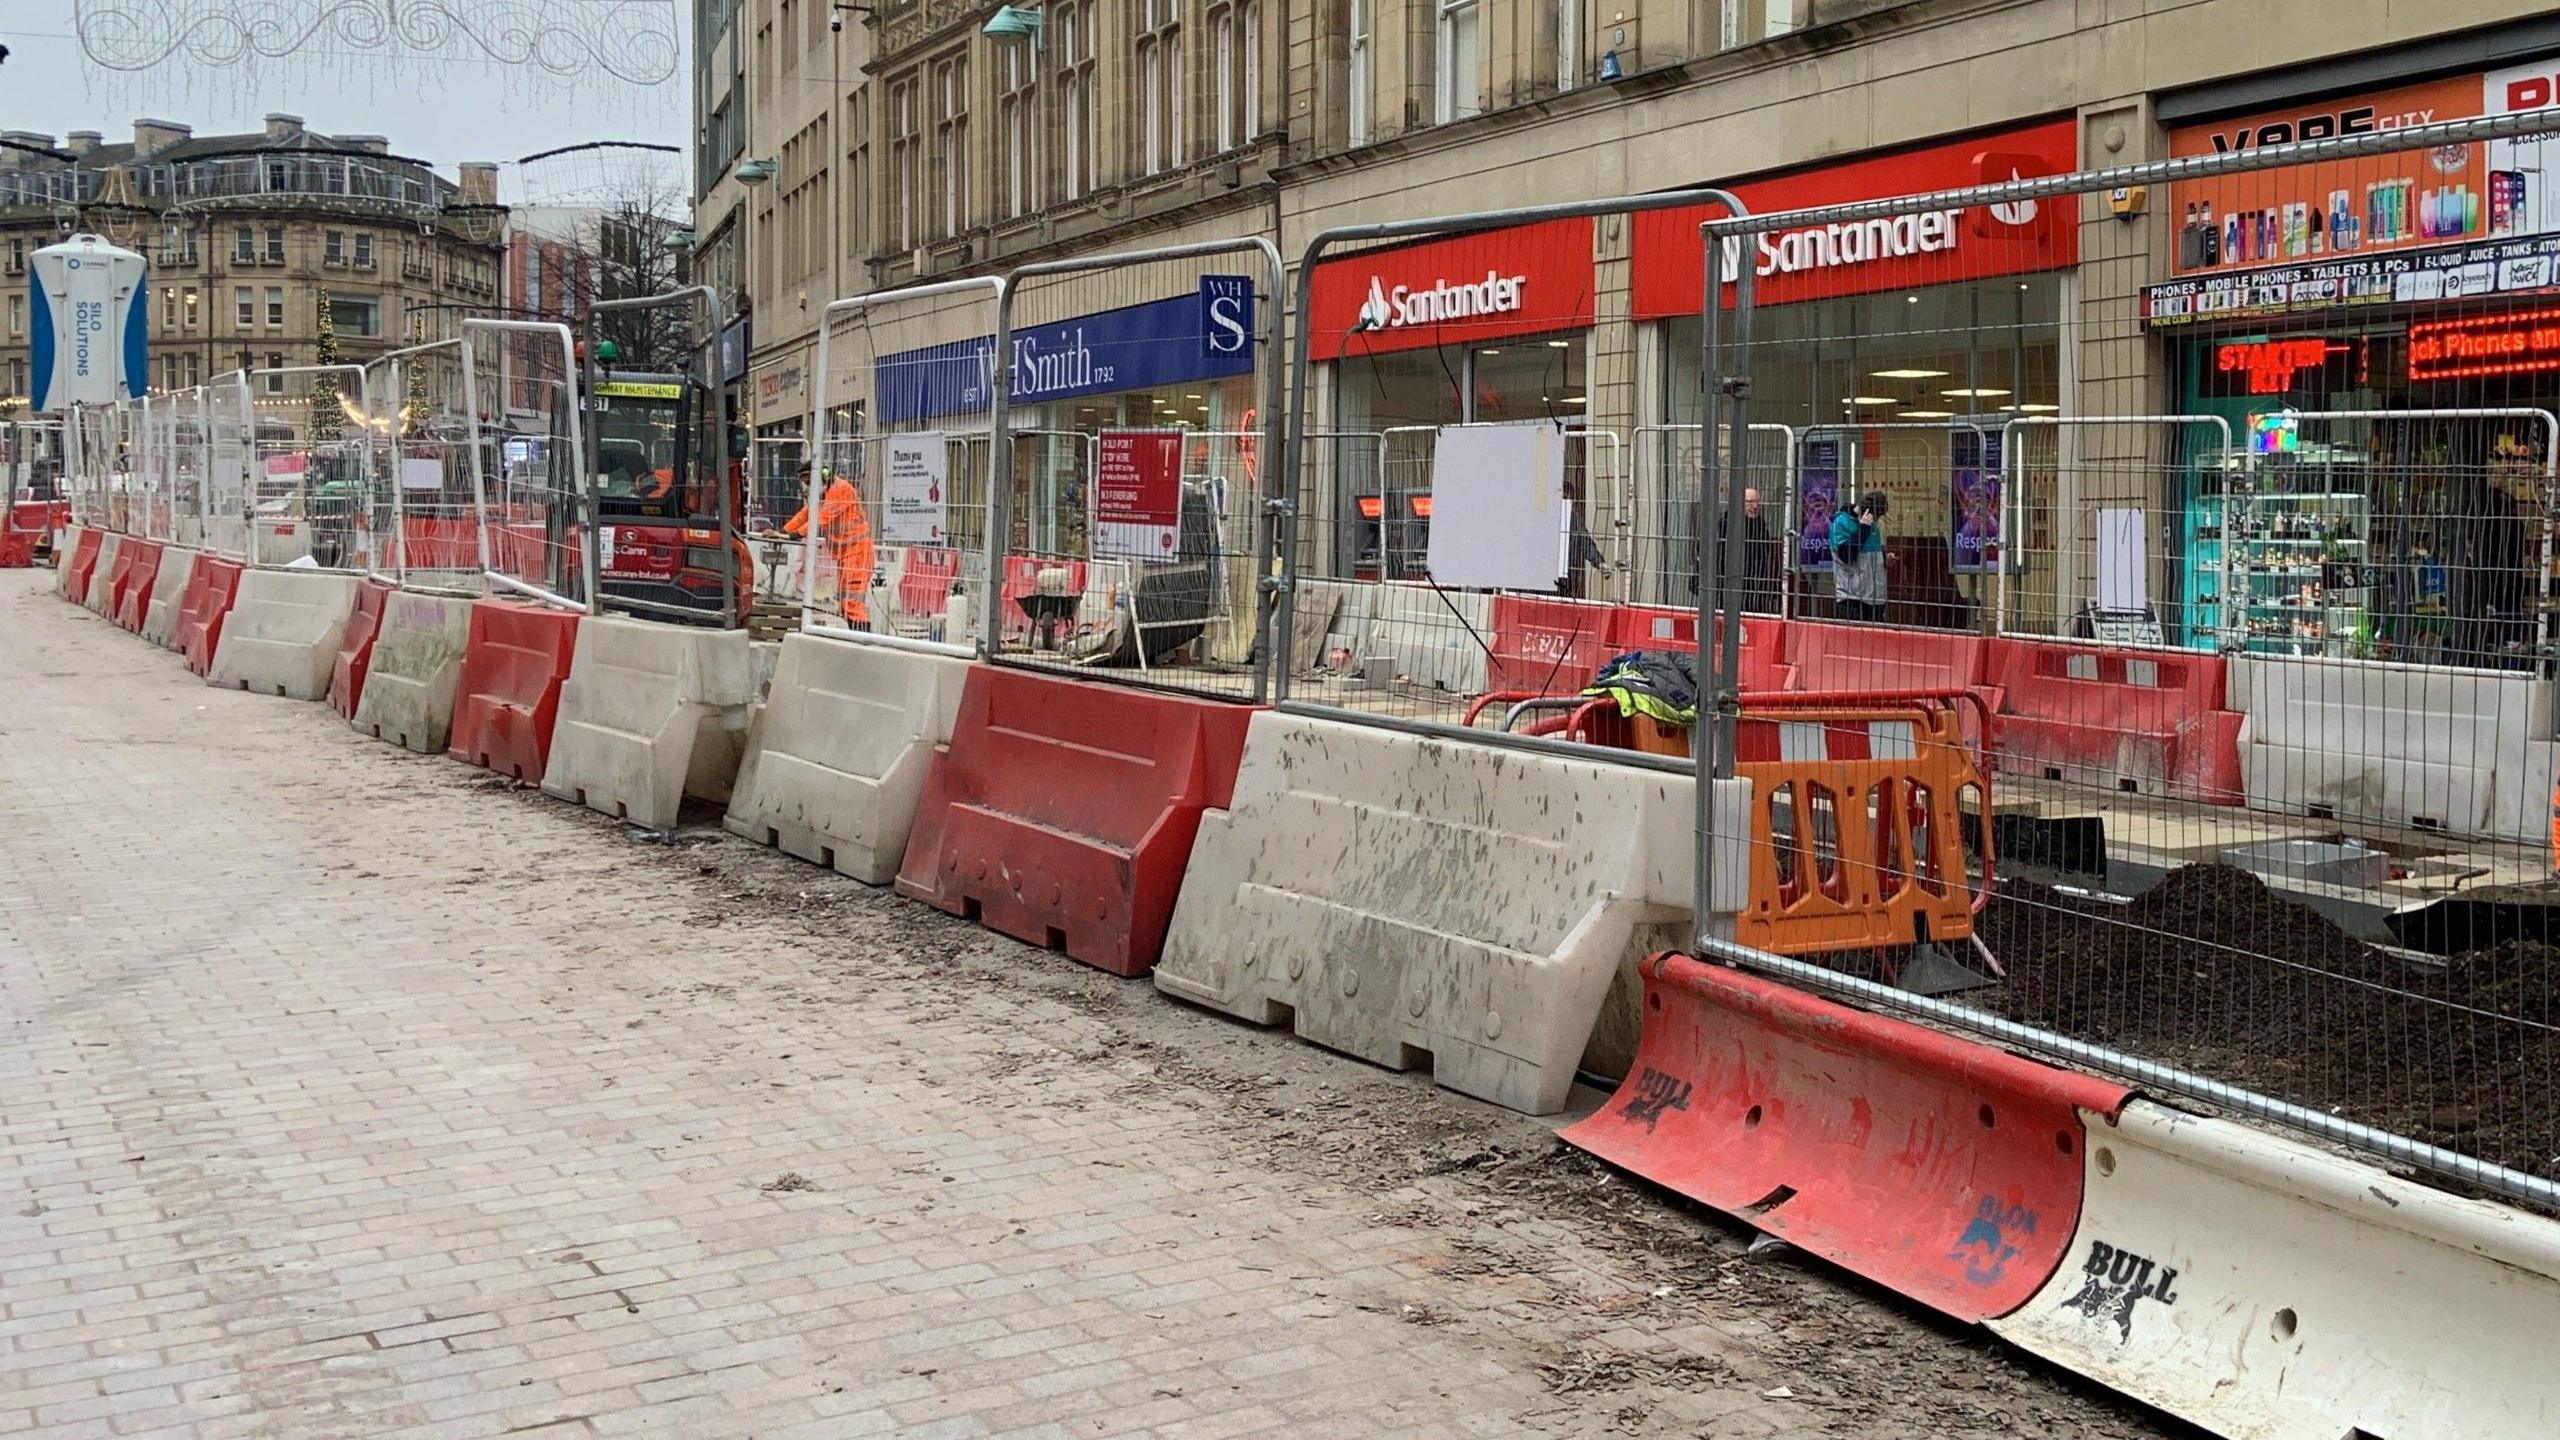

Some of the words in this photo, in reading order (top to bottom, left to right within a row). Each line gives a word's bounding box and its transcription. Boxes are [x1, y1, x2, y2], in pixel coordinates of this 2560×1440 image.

[1756, 208, 1965, 277] Santander
[1208, 281, 1242, 296] WH
[2151, 283, 2196, 299] PHONES
[2205, 276, 2249, 292] MOBILE
[2252, 270, 2301, 287] PHONES
[2312, 262, 2368, 279] TABLETS
[2371, 261, 2381, 273] &
[2385, 259, 2410, 273] PCs
[2467, 248, 2494, 262] JUICE
[2501, 243, 2532, 258] TANKS
[90, 302, 102, 332] SILO
[1391, 270, 1526, 328] Santander
[76, 301, 88, 377] SOLUTIONS
[1209, 297, 1245, 352] S
[625, 384, 678, 397] MAINTENANCE
[1093, 366, 1115, 385] 1792
[911, 452, 922, 464] you
[1634, 1066, 1692, 1111] BULL
[2082, 1239, 2178, 1306] BULL
